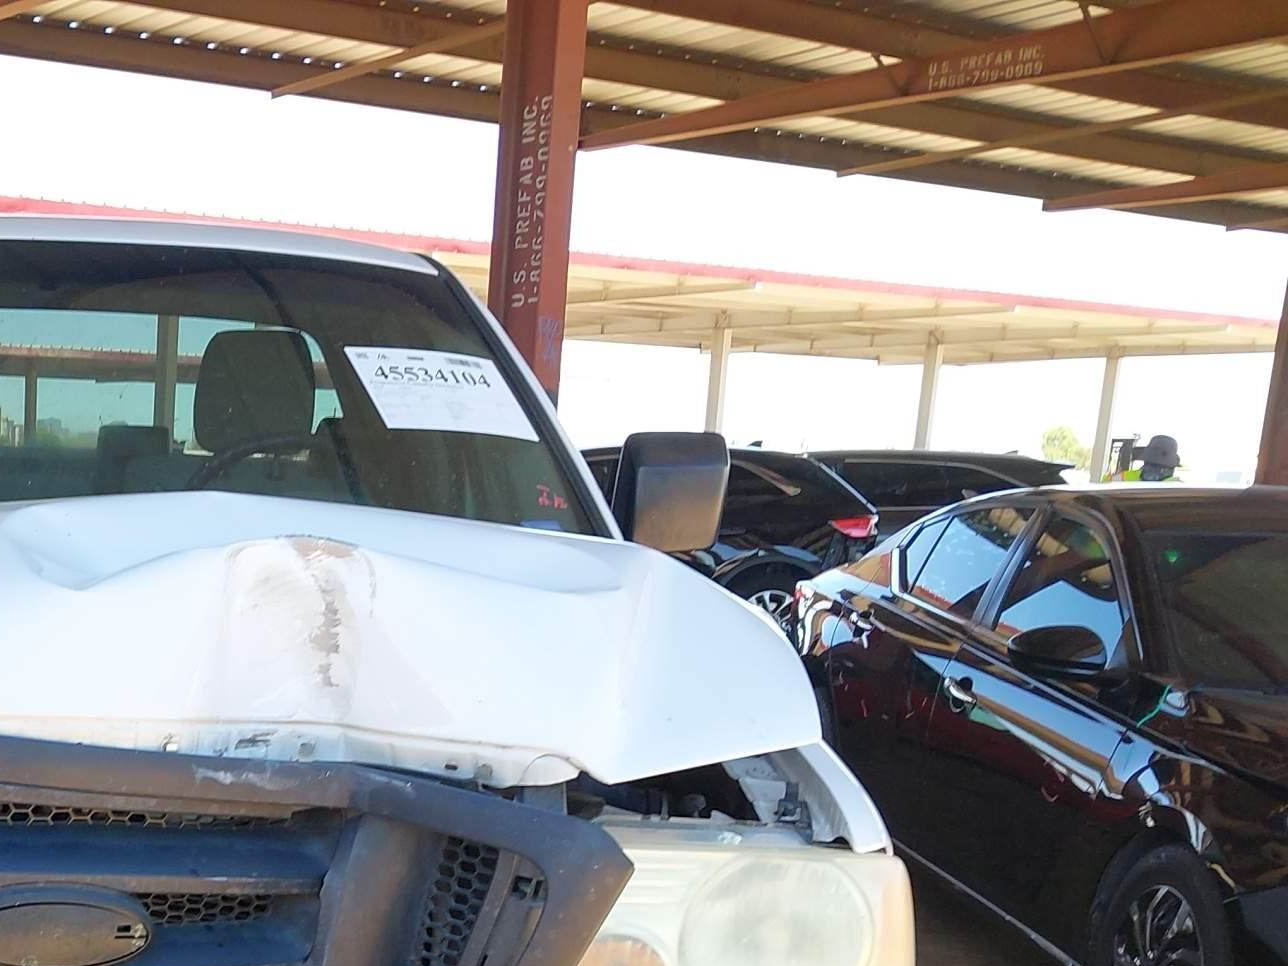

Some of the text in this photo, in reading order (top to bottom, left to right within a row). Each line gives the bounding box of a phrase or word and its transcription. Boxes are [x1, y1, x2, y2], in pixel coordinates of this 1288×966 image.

[928, 45, 1046, 77] U.S. PREFAB INC.
[511, 95, 540, 308] U.S. PREFAB INC.
[374, 364, 491, 388] 45534104
